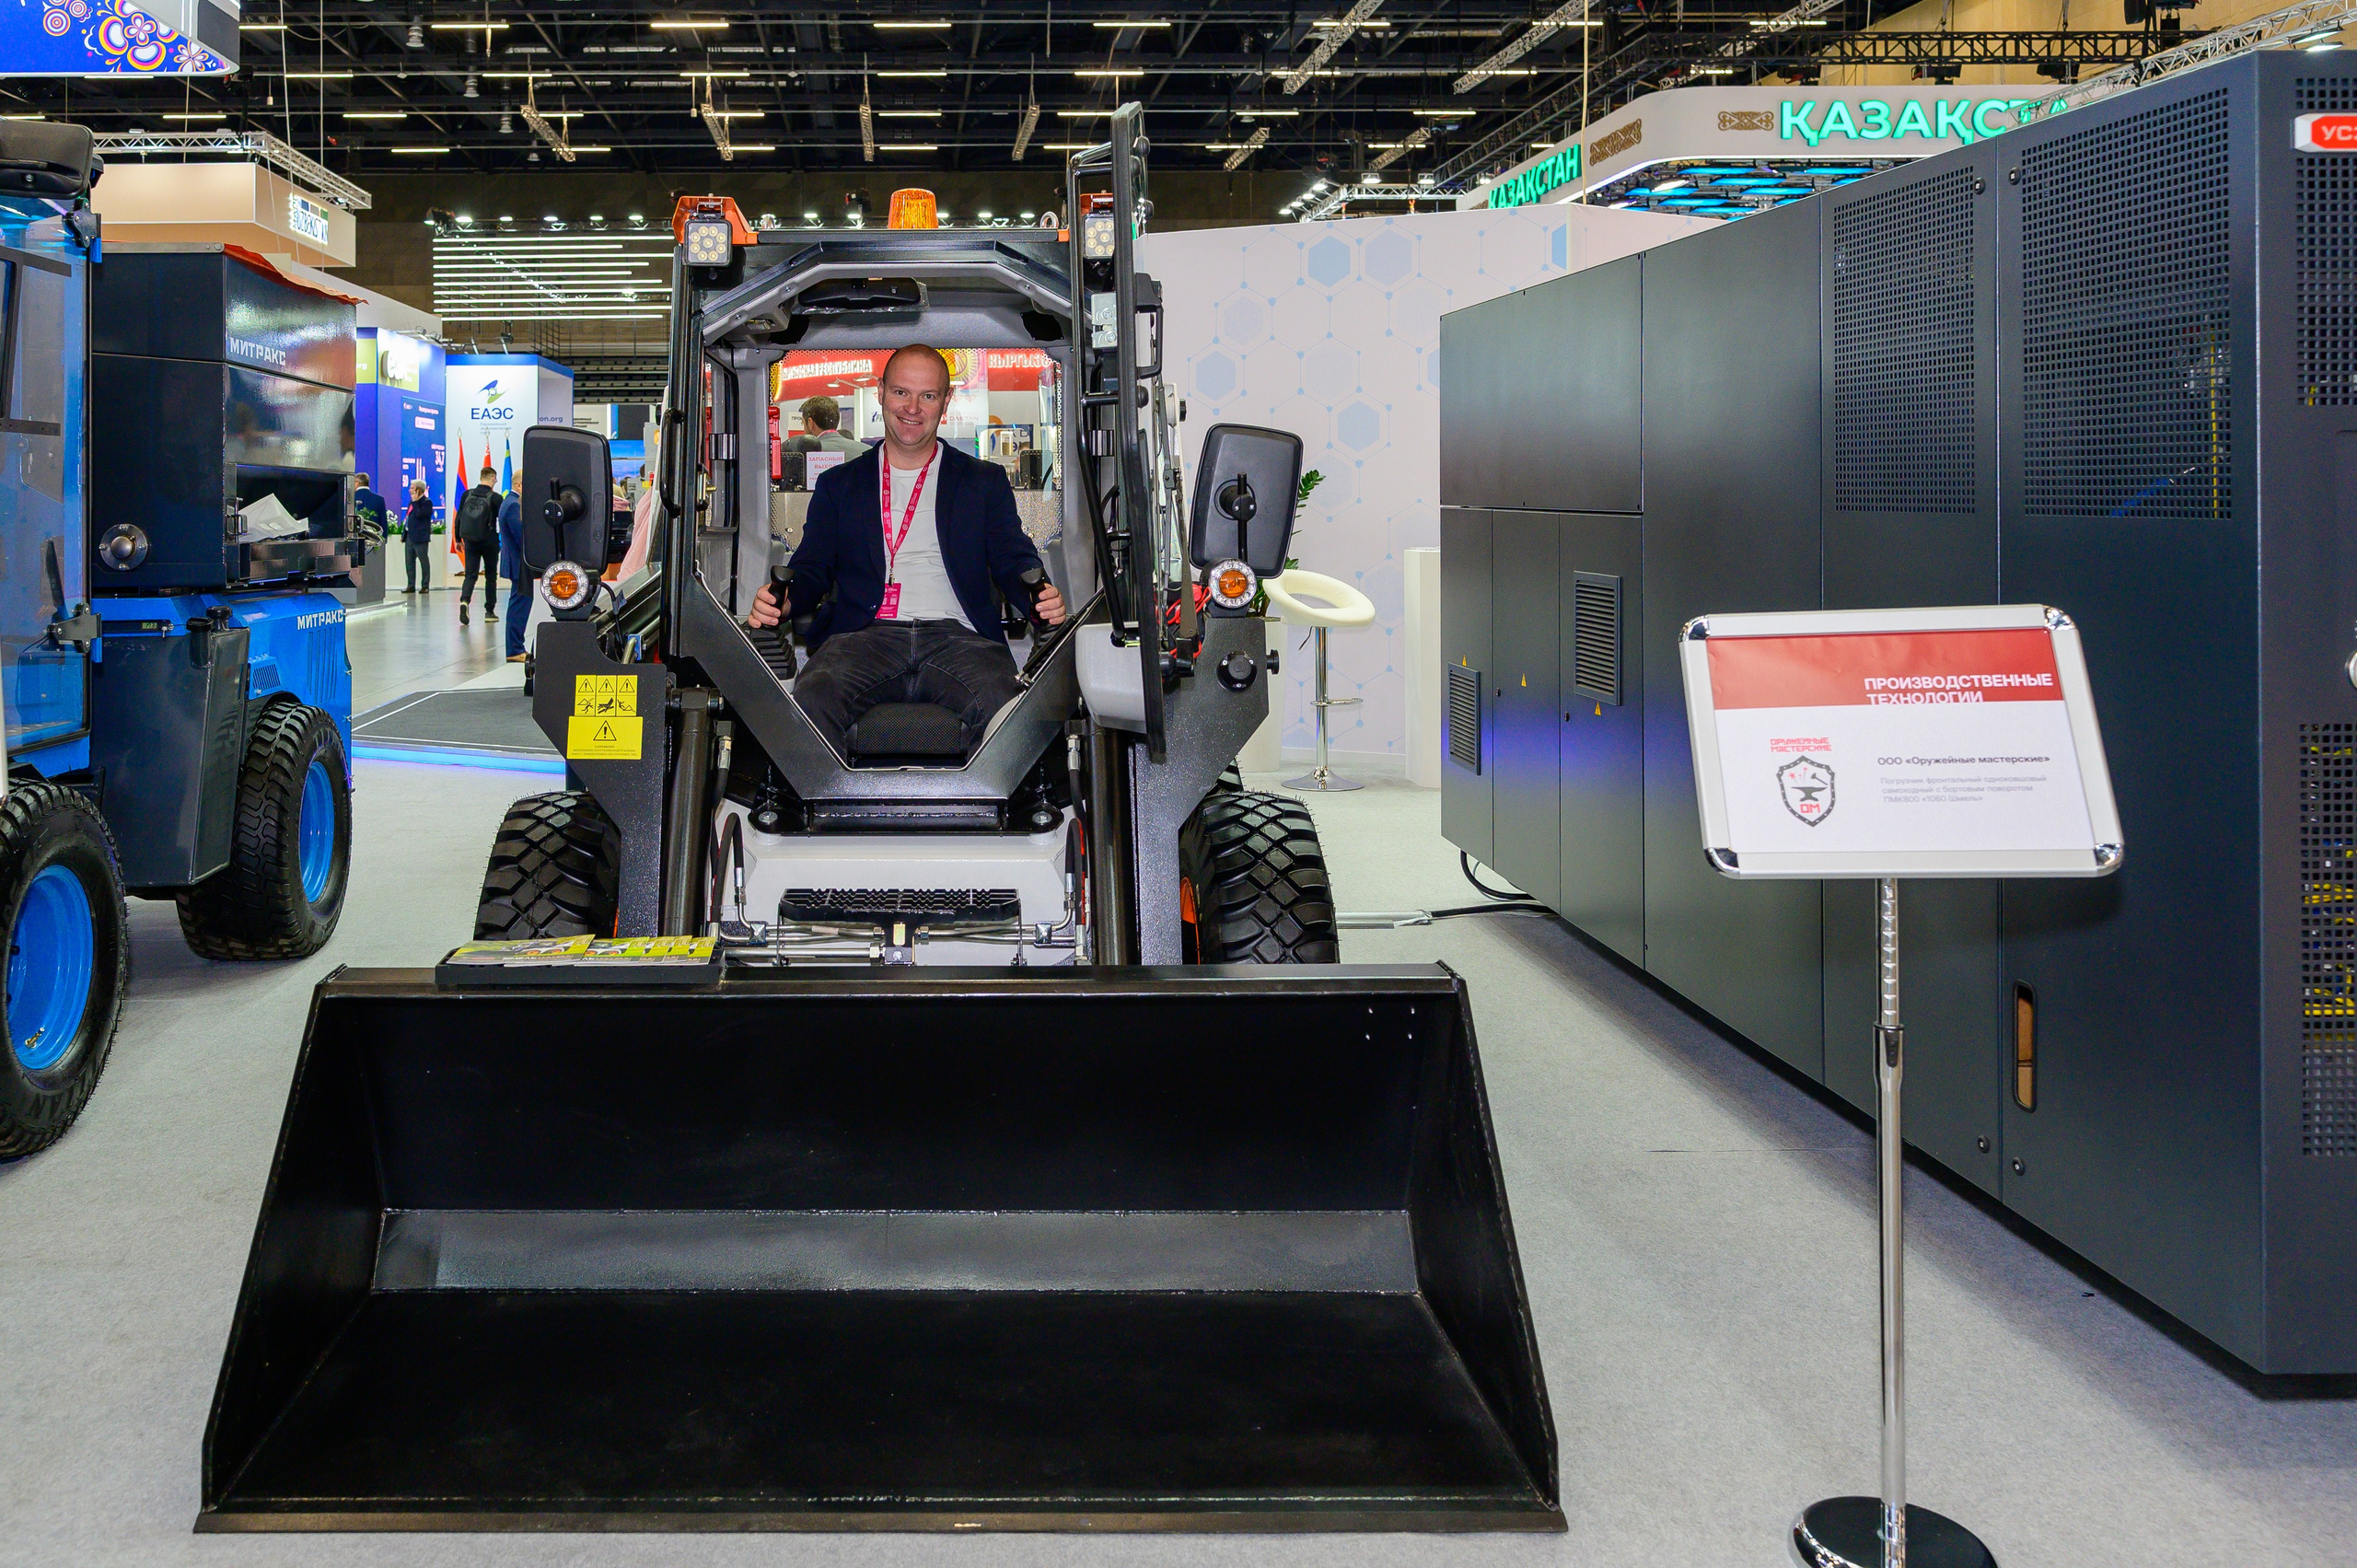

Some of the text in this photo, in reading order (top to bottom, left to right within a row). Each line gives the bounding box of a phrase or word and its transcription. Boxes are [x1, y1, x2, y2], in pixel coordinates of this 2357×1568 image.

[2321, 125, 2357, 141] УС
[229, 337, 286, 366] МИТРАКС
[470, 407, 514, 420] ЕАЭС
[296, 609, 343, 630] МИТРАКС
[1864, 673, 2053, 691] ПРОИЗВОДСТВЕННЫЕ
[1866, 691, 1984, 705] ТЕХНОЛОГИИ
[1877, 756, 2049, 766] ООО «Оружейные мастерские»
[1800, 803, 1821, 814] ОМ
